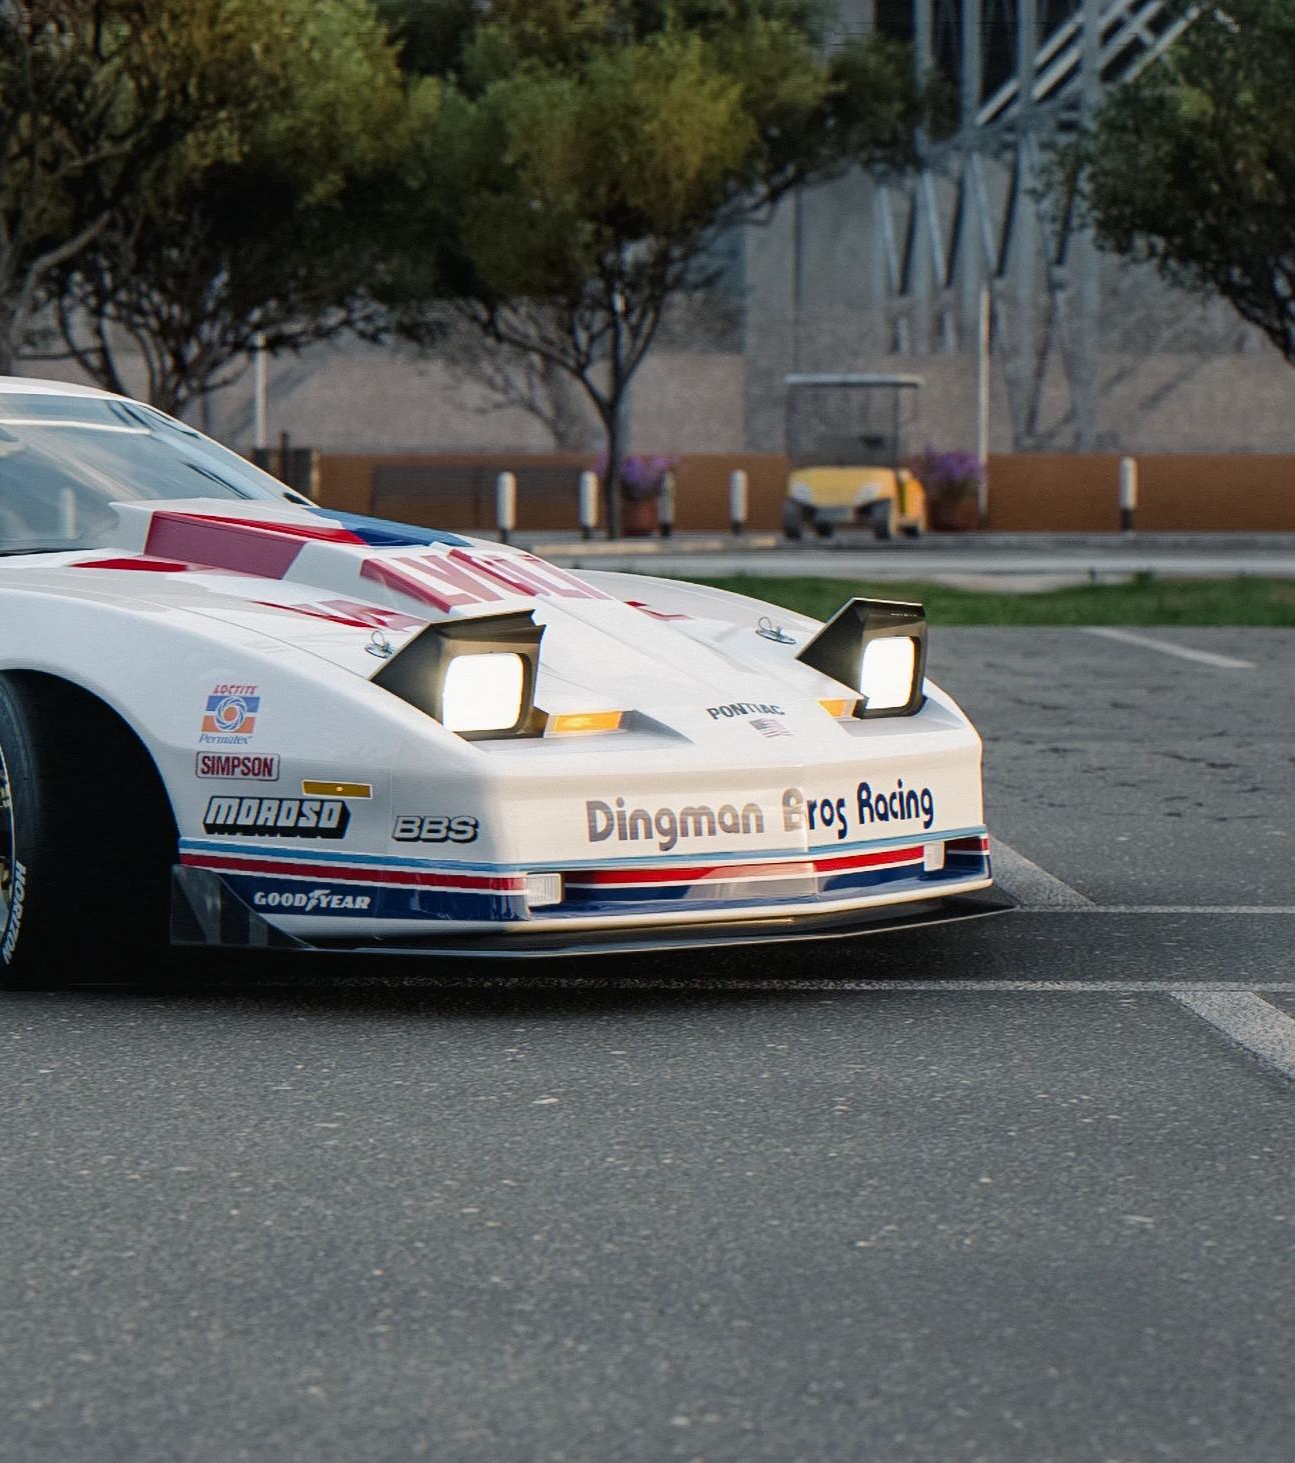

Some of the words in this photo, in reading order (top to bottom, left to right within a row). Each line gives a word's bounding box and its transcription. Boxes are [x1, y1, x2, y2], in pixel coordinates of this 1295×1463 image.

[213, 684, 259, 695] LOCTITE
[706, 703, 786, 720] PONTIAC
[200, 755, 274, 778] SIMPSON
[204, 797, 346, 834] MOROSO
[392, 815, 479, 844] BBS
[585, 796, 765, 852] Dingman
[782, 787, 848, 841] Bros
[857, 778, 935, 830] Racing
[2, 860, 27, 965] HORIZON
